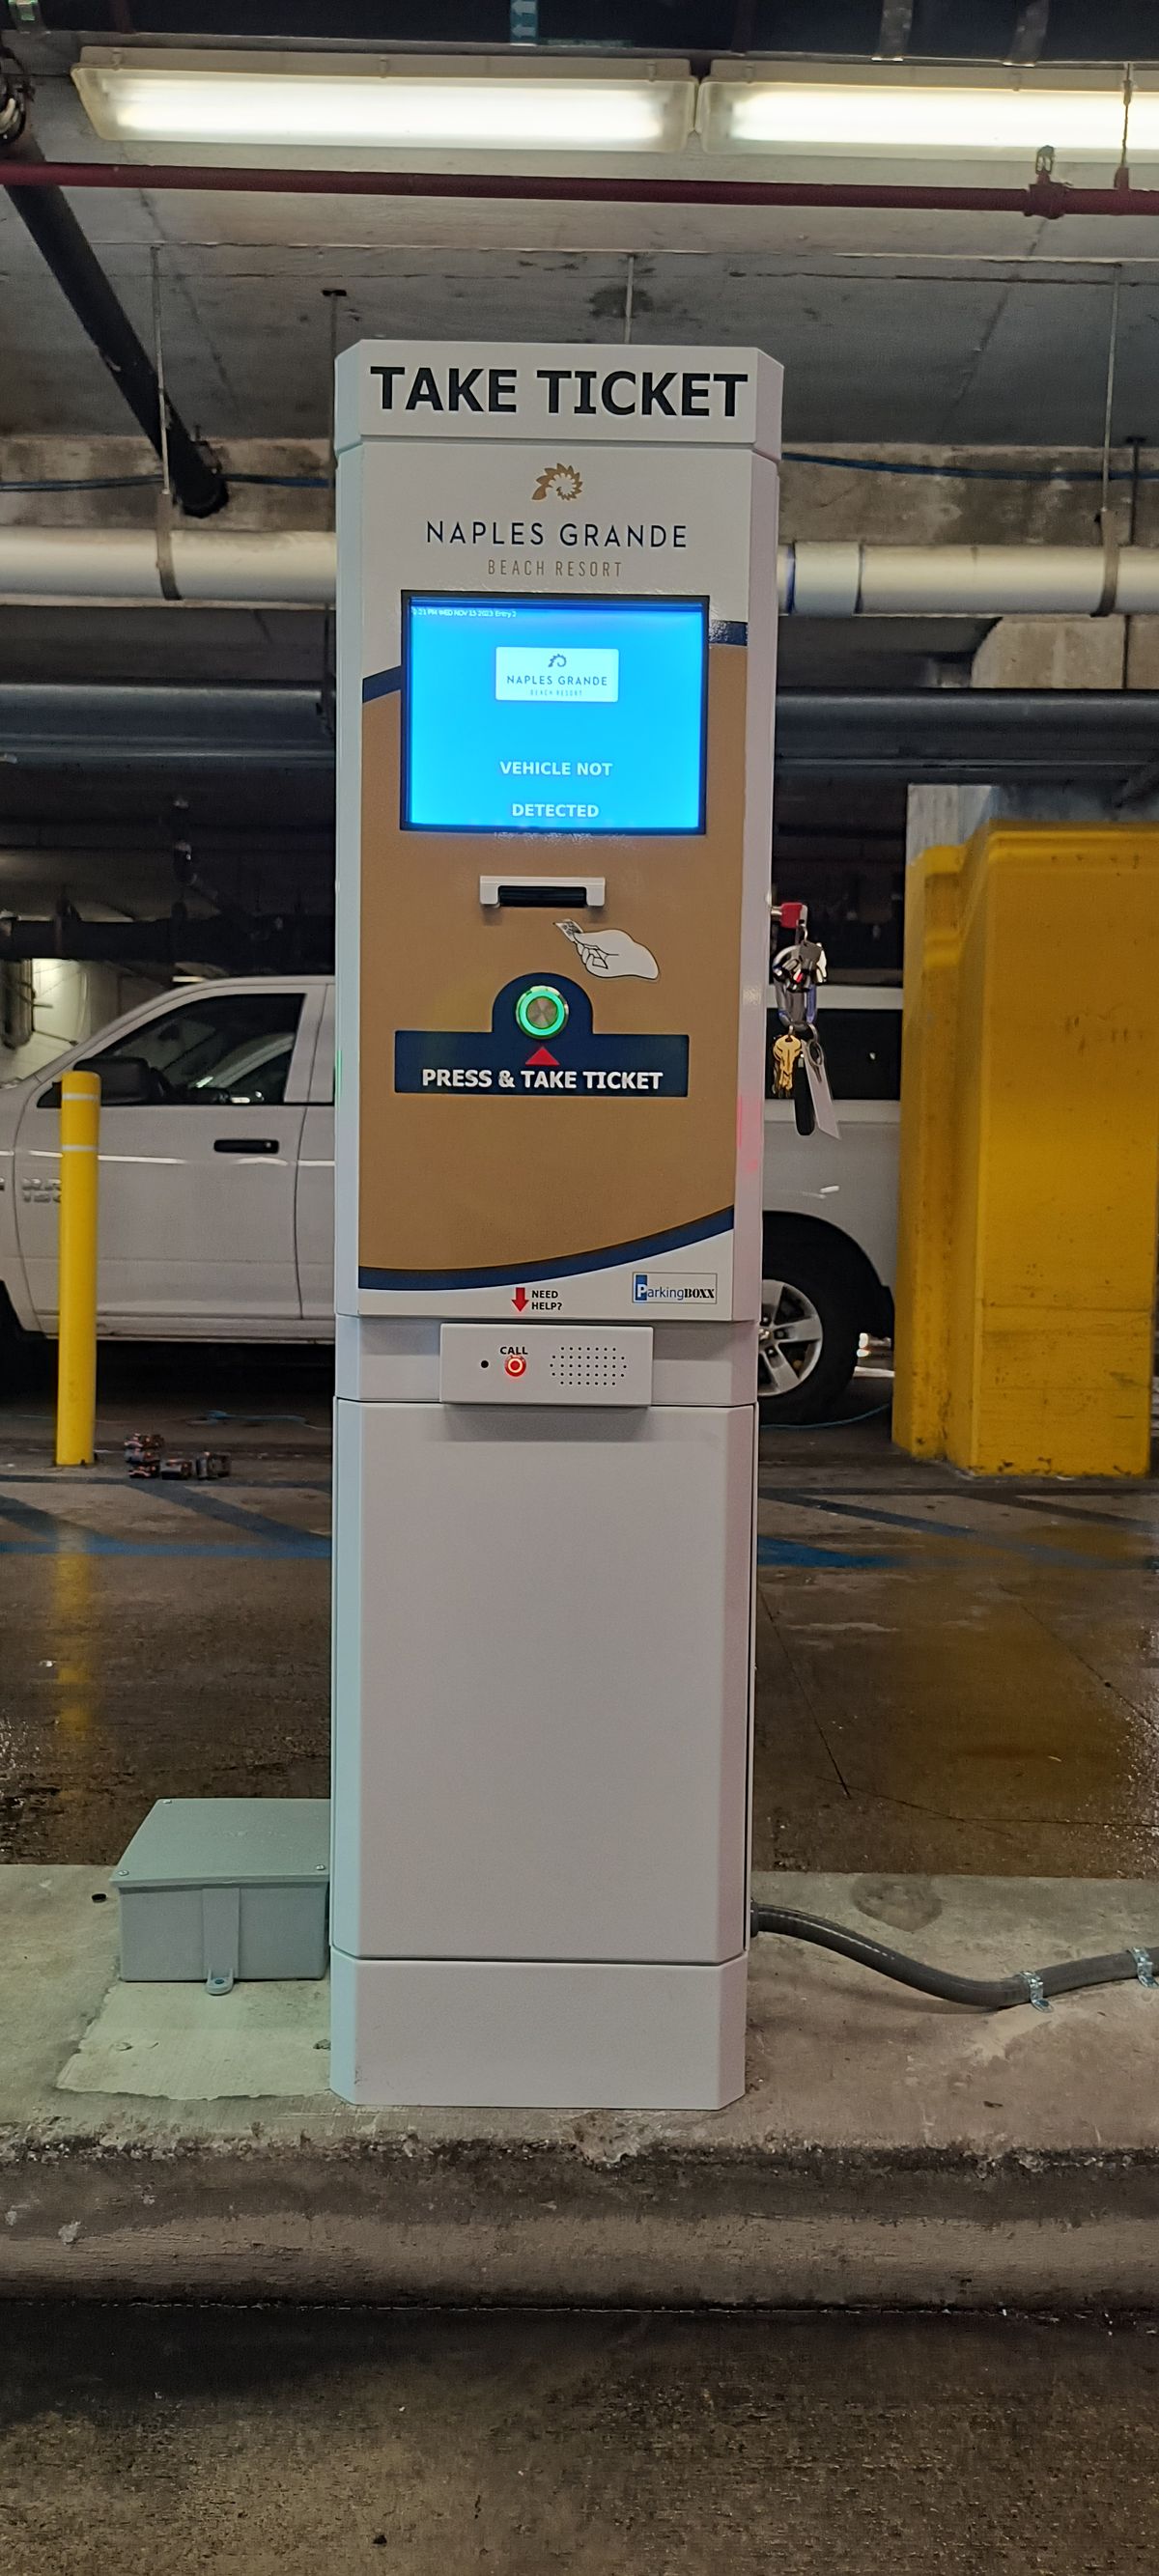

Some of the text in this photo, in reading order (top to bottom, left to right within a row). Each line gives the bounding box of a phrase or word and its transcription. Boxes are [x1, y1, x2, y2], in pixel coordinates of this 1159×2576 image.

[370, 366, 749, 418] TAKE TICKET
[427, 521, 687, 548] NAPLES GRANDE
[488, 559, 622, 577] BEACH RESORT
[507, 675, 608, 686] NAPLES GRANDE
[499, 761, 613, 776] VEHICLE NOT
[512, 803, 599, 819] DETECTED
[422, 1068, 664, 1090] PRESS & TAKE TICKET
[531, 1290, 558, 1299] NEED
[636, 1282, 715, 1301] ParkingBOXX
[531, 1302, 563, 1311] HELP?
[499, 1346, 528, 1356] CALL
